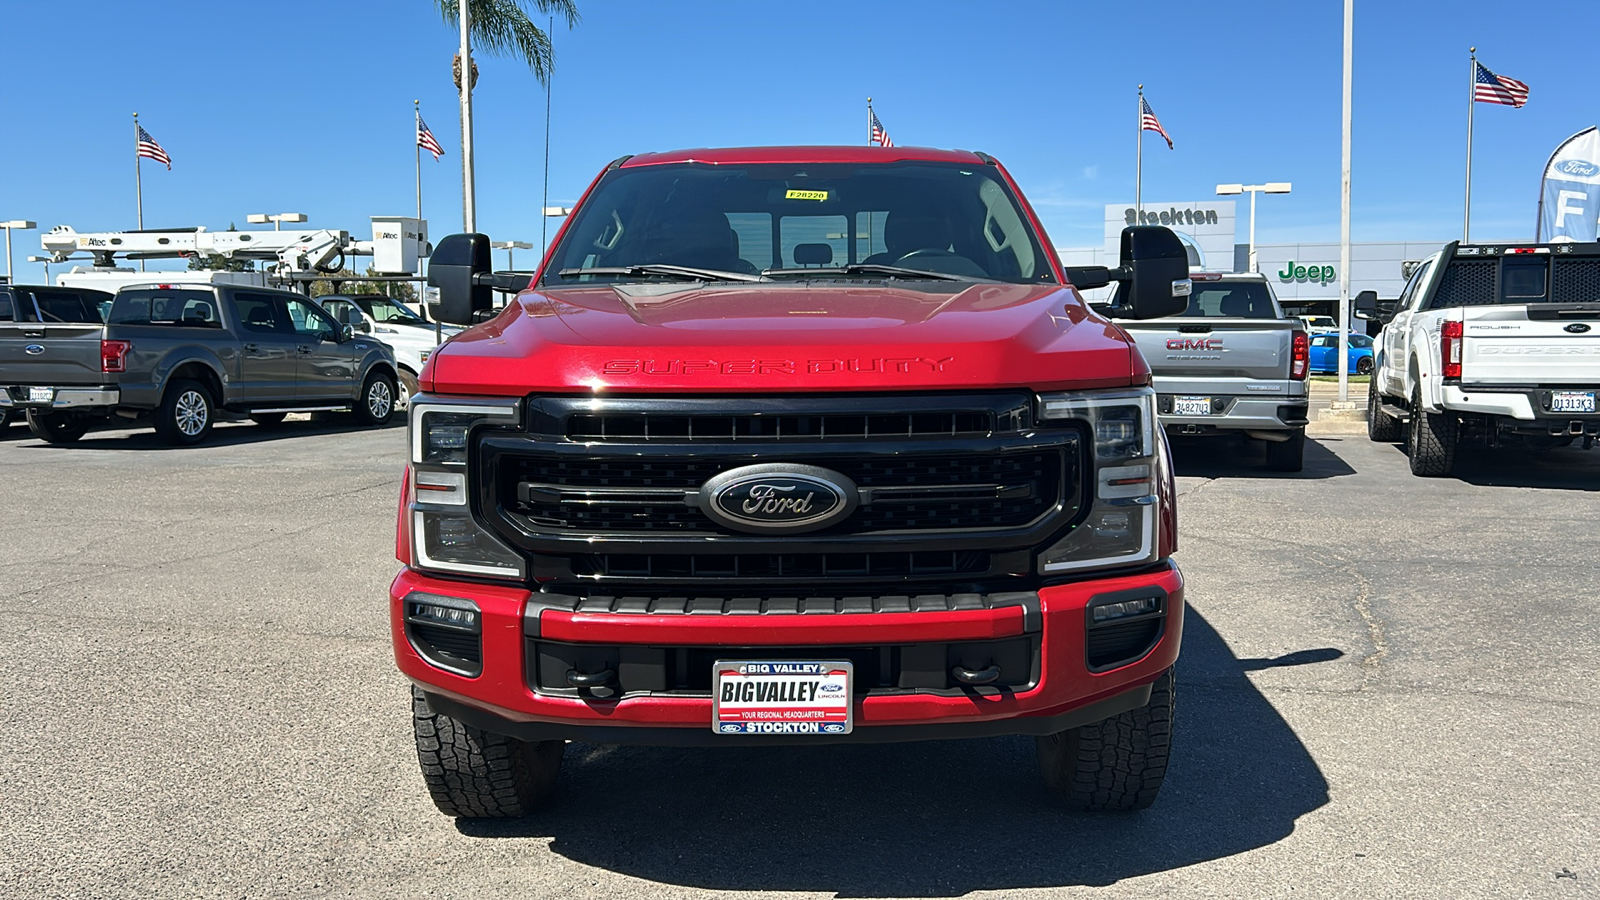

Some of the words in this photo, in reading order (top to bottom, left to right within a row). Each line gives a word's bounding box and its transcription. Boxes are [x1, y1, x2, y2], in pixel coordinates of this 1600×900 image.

[1564, 160, 1594, 176] Ford
[1124, 207, 1218, 226] Stockton
[1278, 261, 1336, 284] Jeep
[1166, 338, 1224, 351] GMC
[602, 358, 796, 376] SUPER
[806, 355, 955, 373] DUTY
[742, 484, 815, 514] Ford
[747, 664, 770, 673] BIG
[772, 664, 819, 673] VALLEY
[741, 711, 757, 719] YOUR
[757, 711, 783, 719] REGIONAL
[783, 710, 825, 719] HEADQUARTERS
[746, 721, 819, 733] STOCKTON
